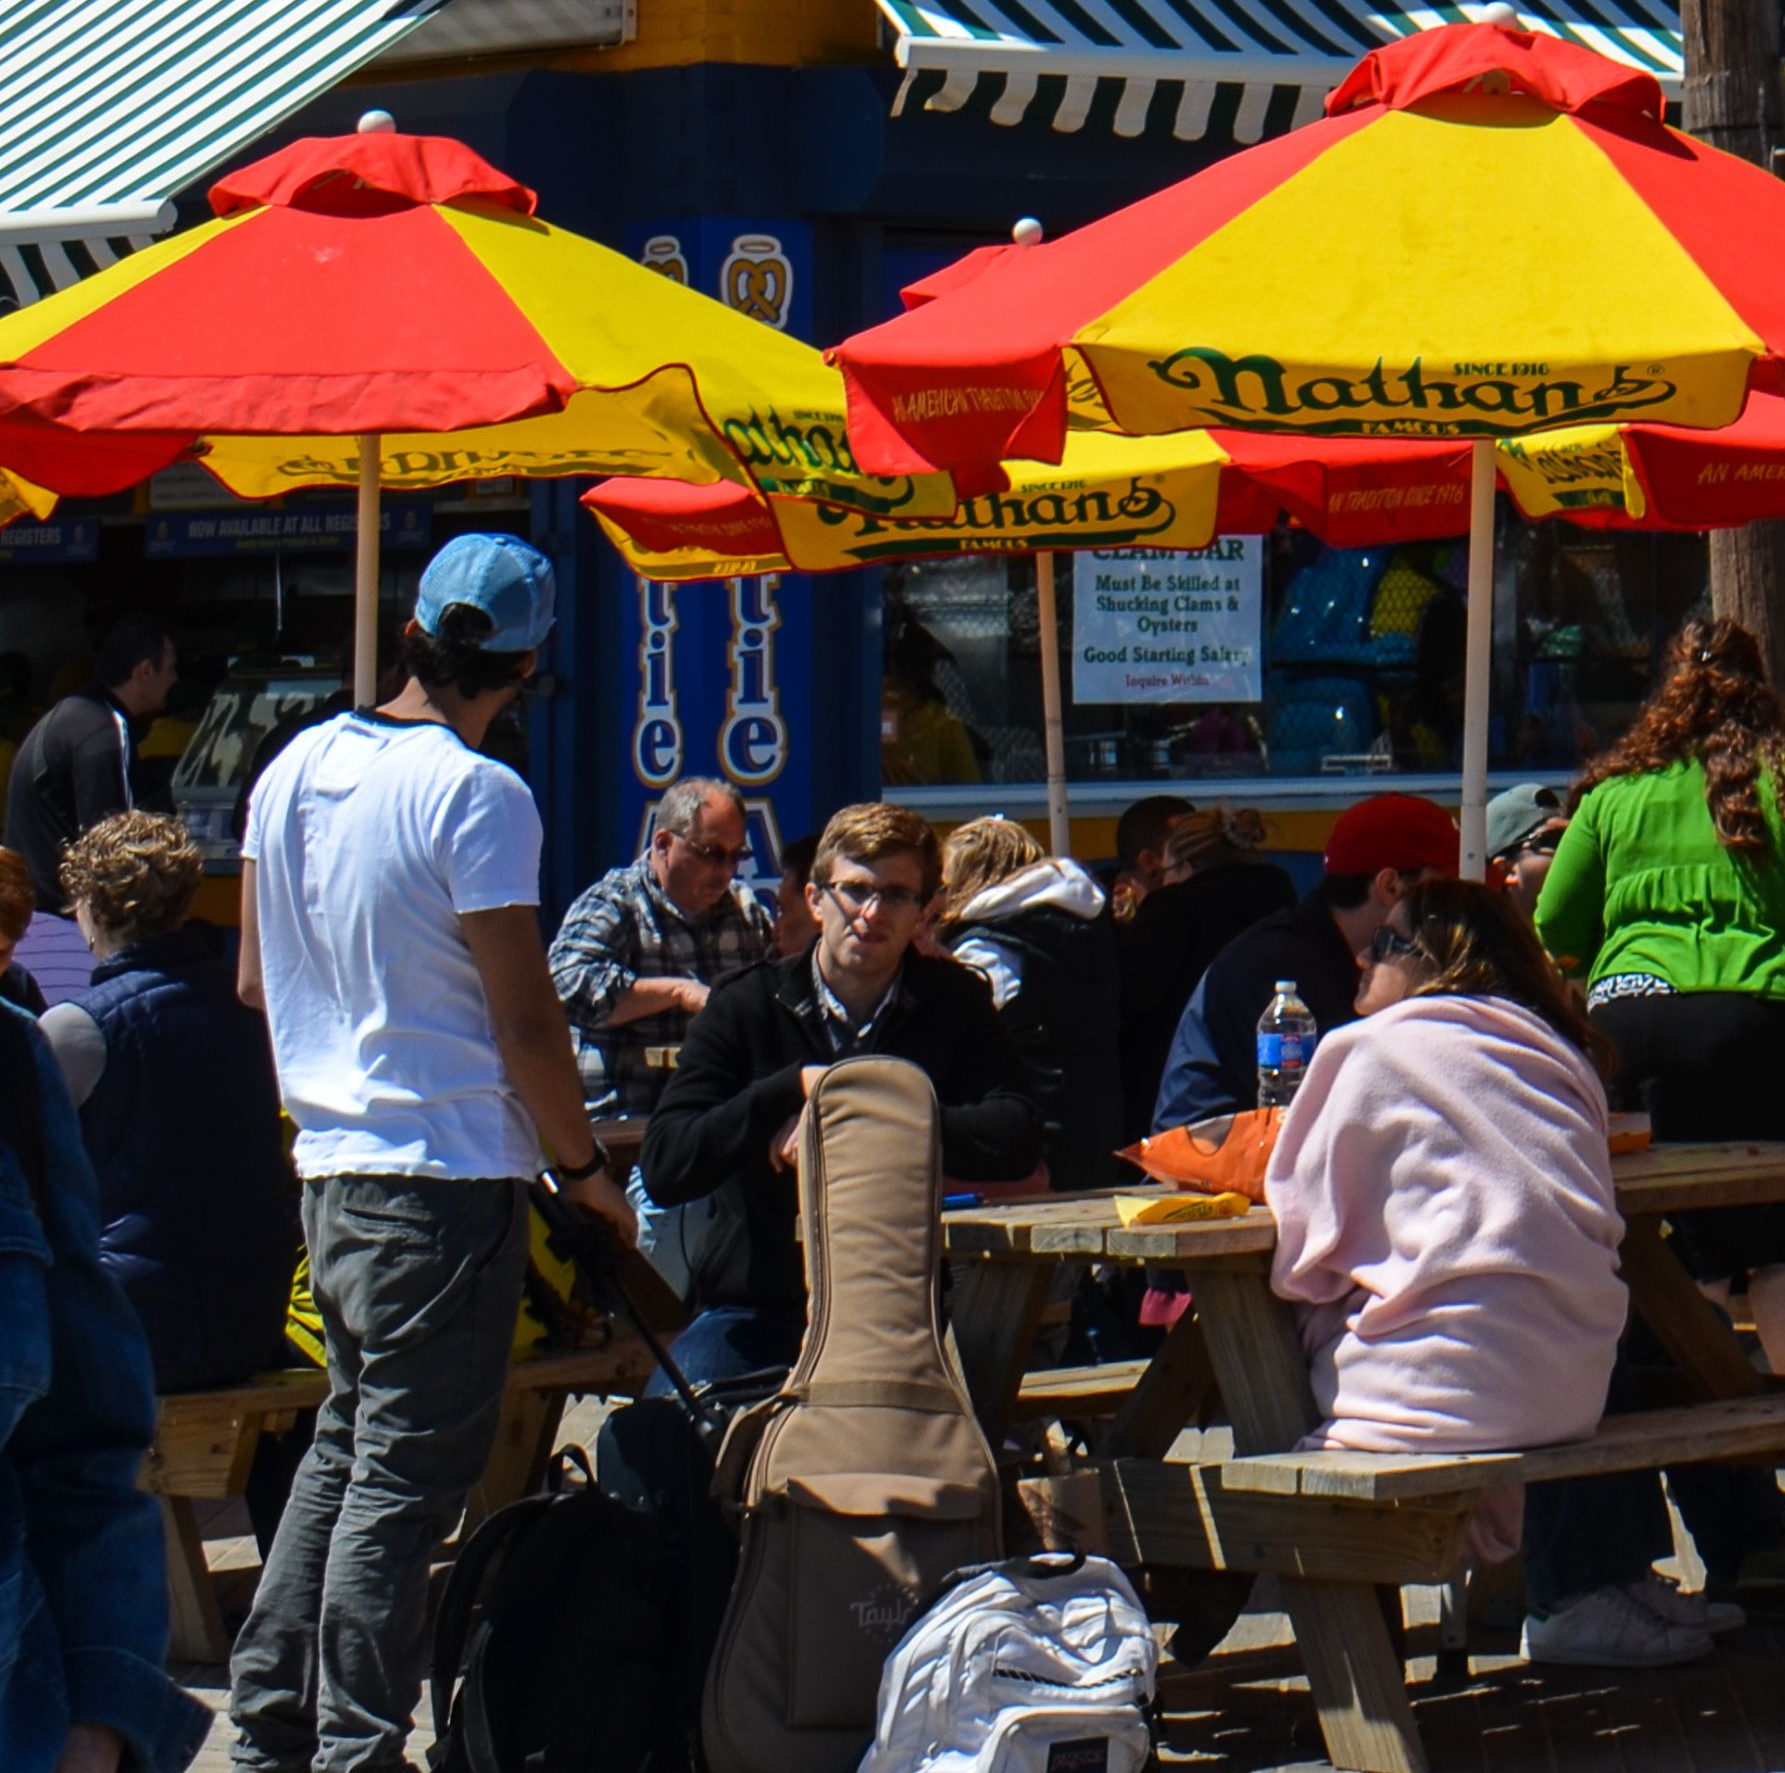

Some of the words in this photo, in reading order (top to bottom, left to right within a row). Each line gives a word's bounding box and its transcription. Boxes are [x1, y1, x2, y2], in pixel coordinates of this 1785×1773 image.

[1452, 362, 1507, 378] SINCE
[1510, 362, 1551, 377] 1916
[1362, 419, 1462, 437] FAMOUS
[1697, 463, 1727, 485] AN
[188, 520, 217, 539] NOW
[218, 516, 282, 538] AVAILABLE
[283, 518, 298, 535] AT
[300, 516, 322, 535] ALL
[959, 536, 1029, 552] FAMOUS
[1094, 575, 1137, 593] Must
[1141, 576, 1162, 593] Be
[1166, 575, 1220, 593] Skilled
[1224, 576, 1241, 592] at
[1095, 596, 1170, 615] Shucking
[1173, 596, 1223, 612] Clams
[1226, 597, 1240, 612] &
[1136, 616, 1198, 637] Oysters
[1083, 646, 1128, 664] Good
[1132, 646, 1196, 666] Starting
[1125, 674, 1169, 690] Inquire
[1171, 674, 1211, 687] Within
